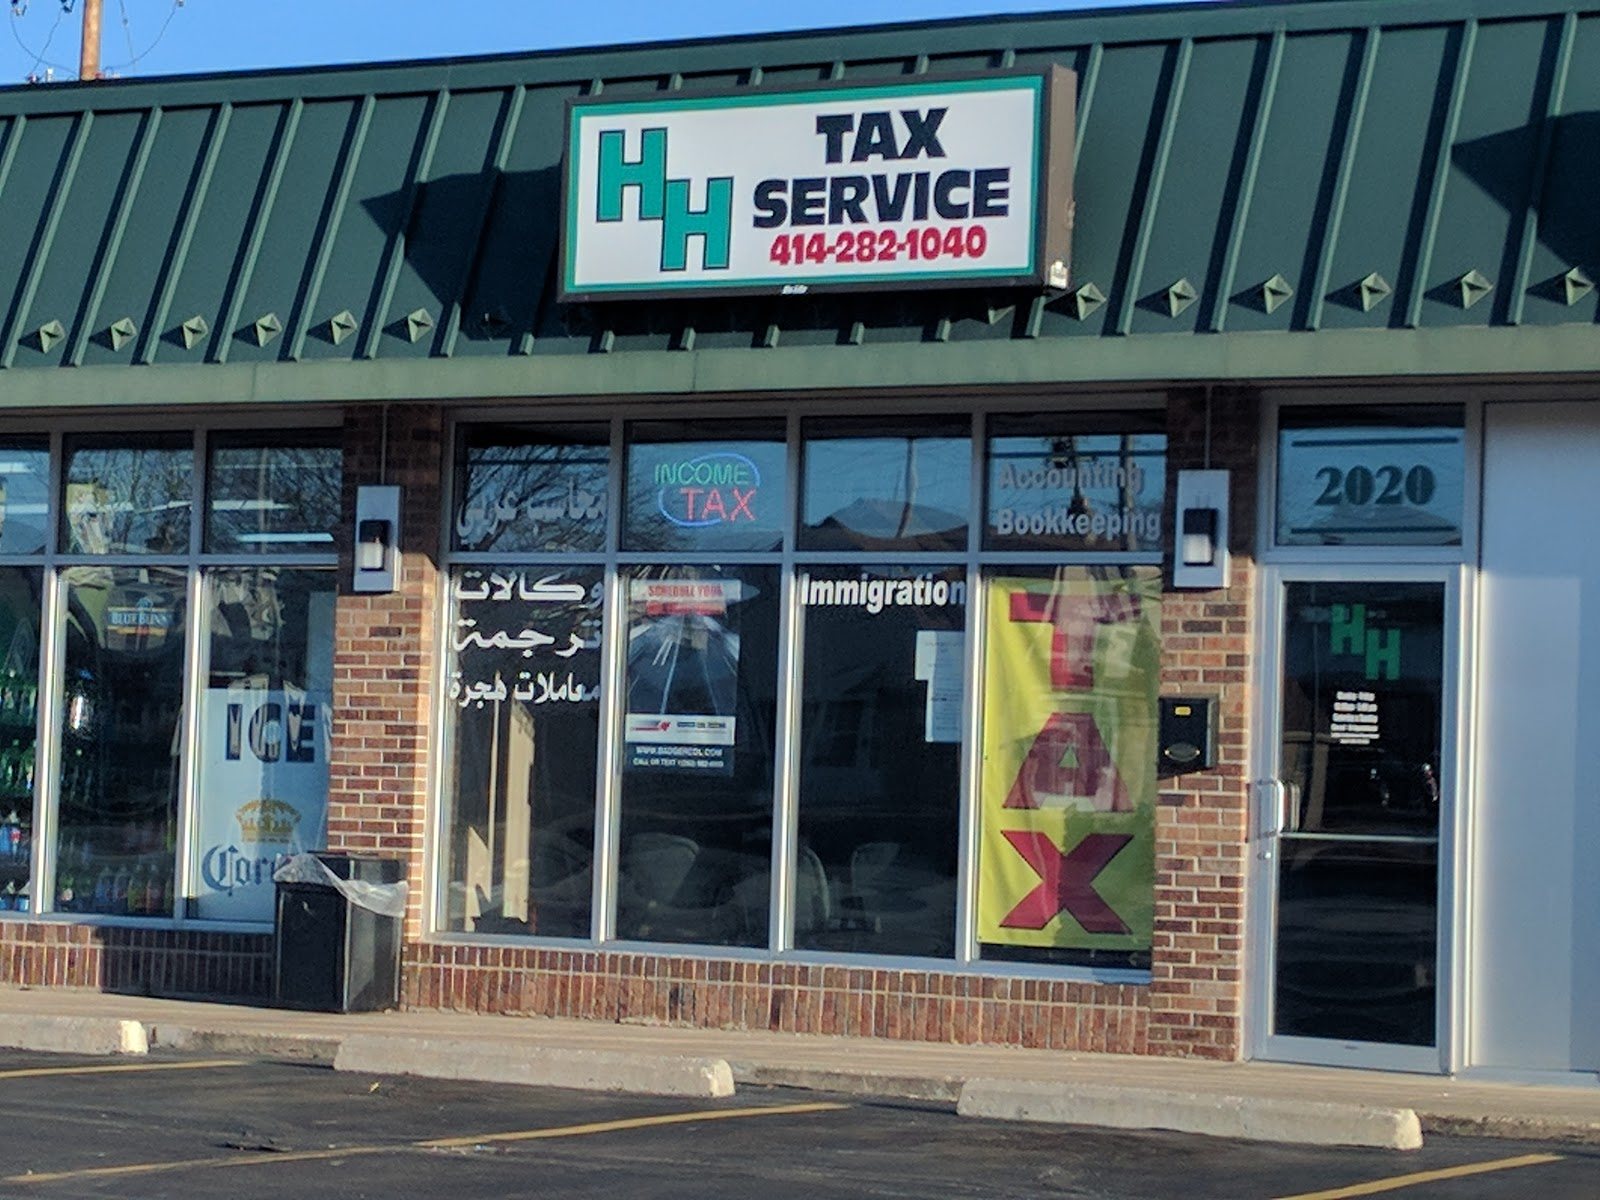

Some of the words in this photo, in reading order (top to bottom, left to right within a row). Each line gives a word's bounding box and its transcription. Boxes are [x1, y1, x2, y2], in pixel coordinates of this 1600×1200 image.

[816, 106, 949, 165] TAX
[752, 166, 1011, 229] SERVICE
[770, 224, 988, 266] 414-282-1040
[655, 463, 750, 486] INCOME
[1000, 461, 1146, 494] Accounting
[1314, 464, 1437, 506] 2020
[681, 487, 756, 522] TAX
[998, 508, 1162, 541] Bookkeeping
[801, 573, 966, 614] Immigration
[452, 618, 602, 658] ترجمة
[226, 703, 315, 763] ICE
